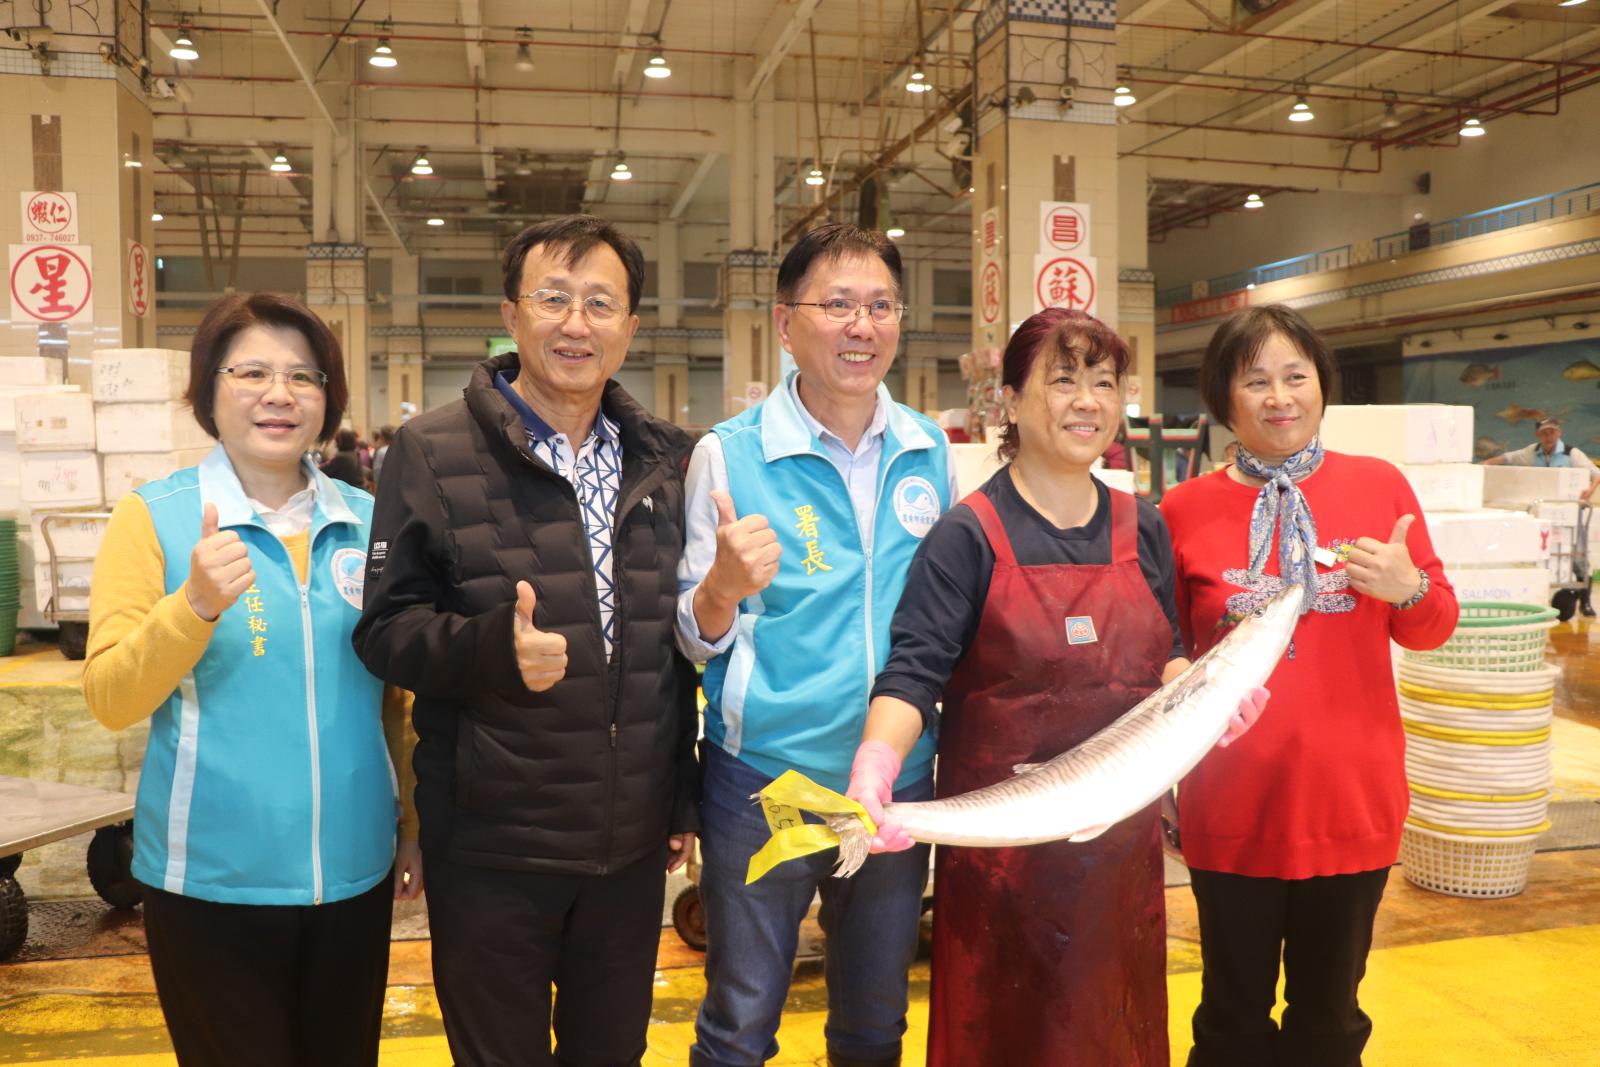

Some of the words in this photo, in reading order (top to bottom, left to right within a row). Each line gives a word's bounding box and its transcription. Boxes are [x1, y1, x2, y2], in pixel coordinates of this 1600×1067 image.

[31, 200, 67, 224] 蝦仁
[1052, 215, 1079, 243] 昌
[29, 254, 72, 314] 星
[1048, 266, 1084, 311] 蘇
[794, 504, 833, 576] 署長
[1462, 588, 1512, 600] SALMON
